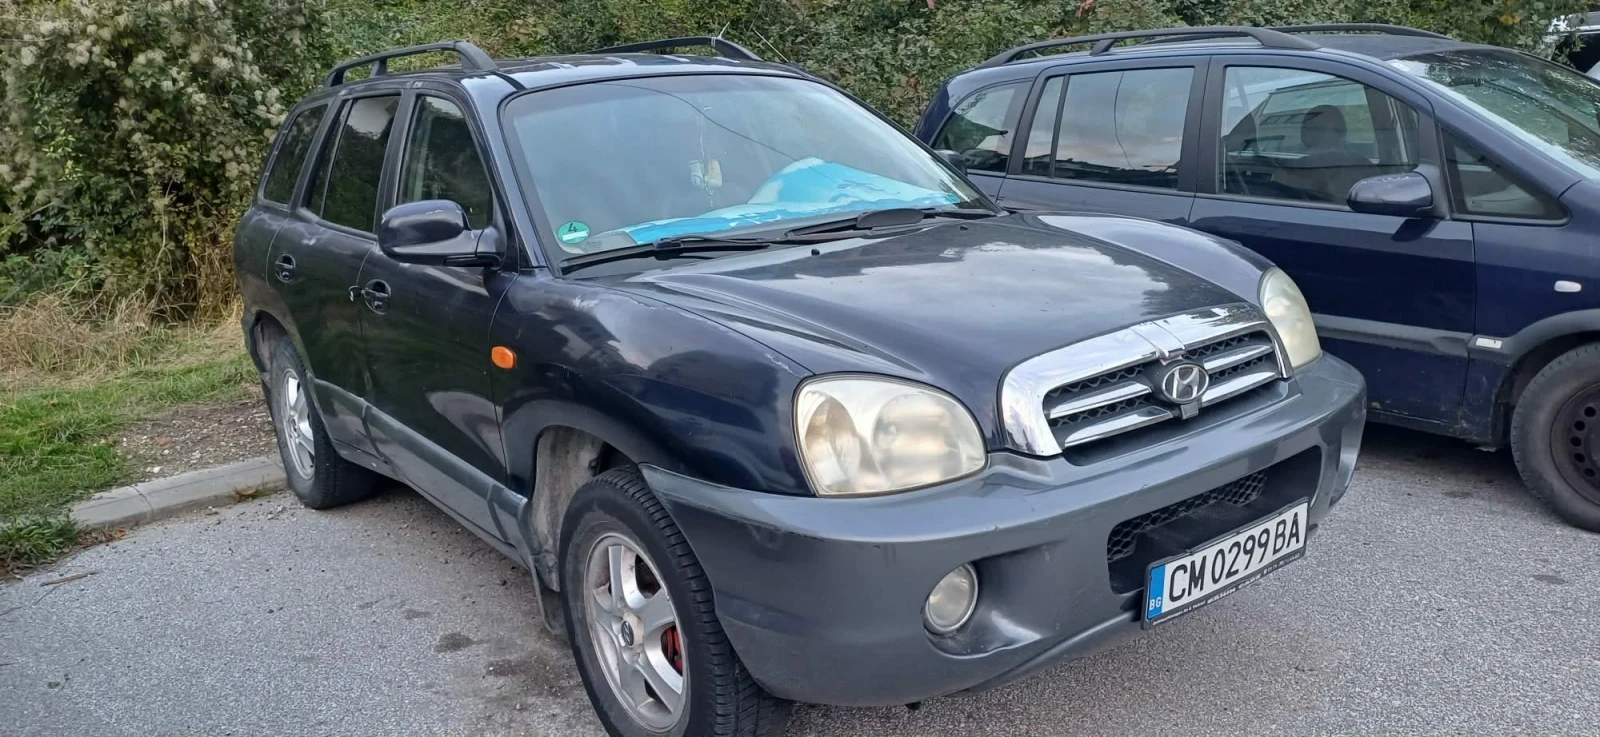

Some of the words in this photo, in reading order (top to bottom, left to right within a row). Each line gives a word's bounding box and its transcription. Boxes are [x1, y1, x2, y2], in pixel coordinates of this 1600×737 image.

[568, 222, 578, 232] 4
[1169, 554, 1207, 603] CM
[1211, 528, 1270, 584] 0299
[1272, 512, 1300, 556] BA
[1149, 596, 1162, 611] BG
